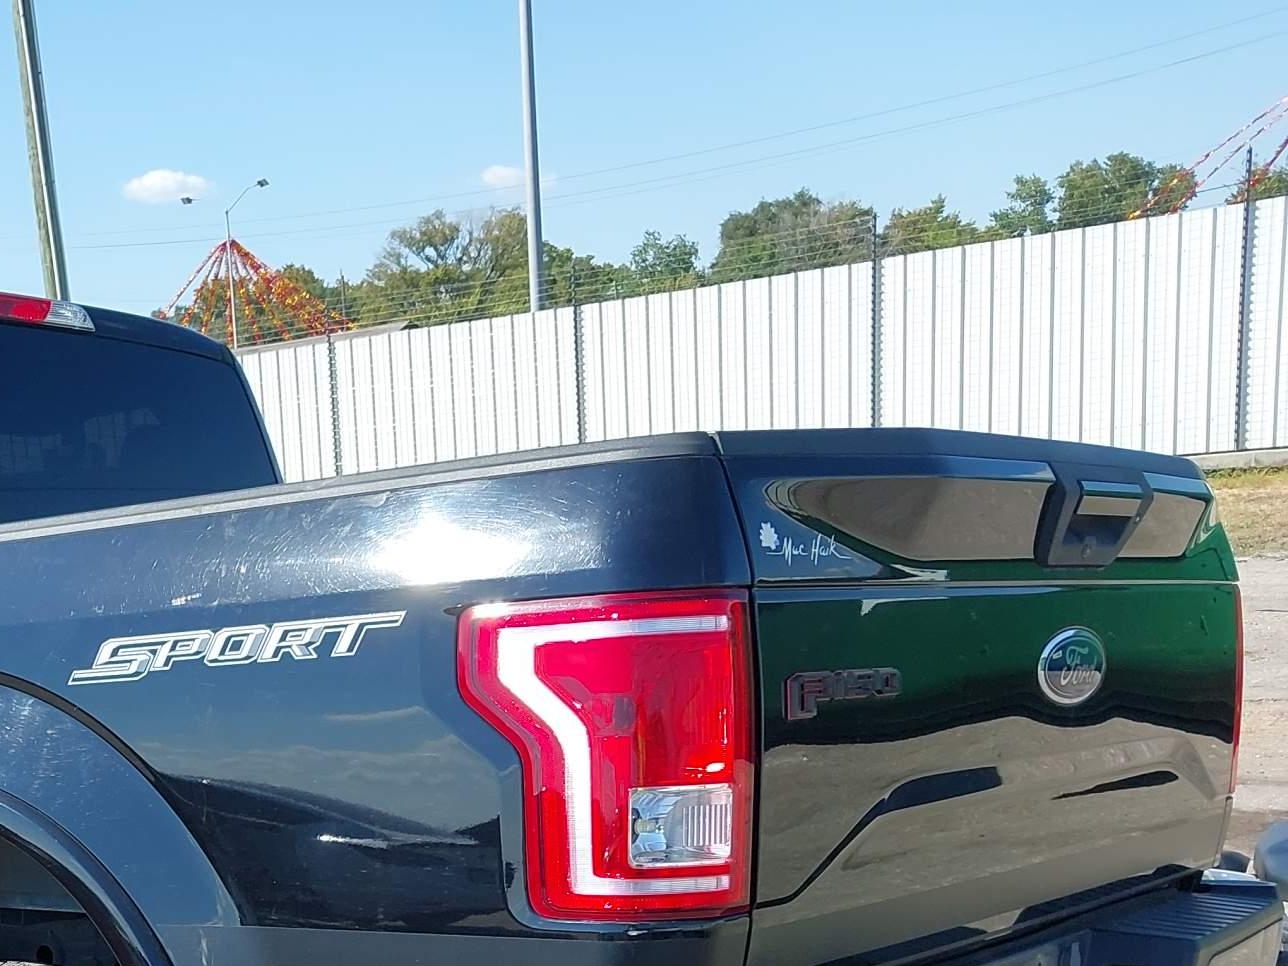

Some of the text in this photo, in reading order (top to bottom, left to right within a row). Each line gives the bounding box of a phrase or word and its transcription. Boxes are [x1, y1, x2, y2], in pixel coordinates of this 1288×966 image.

[810, 532, 852, 567] Haik
[67, 610, 408, 686] SPORT
[1060, 644, 1098, 687] Ford
[781, 666, 903, 721] F150
